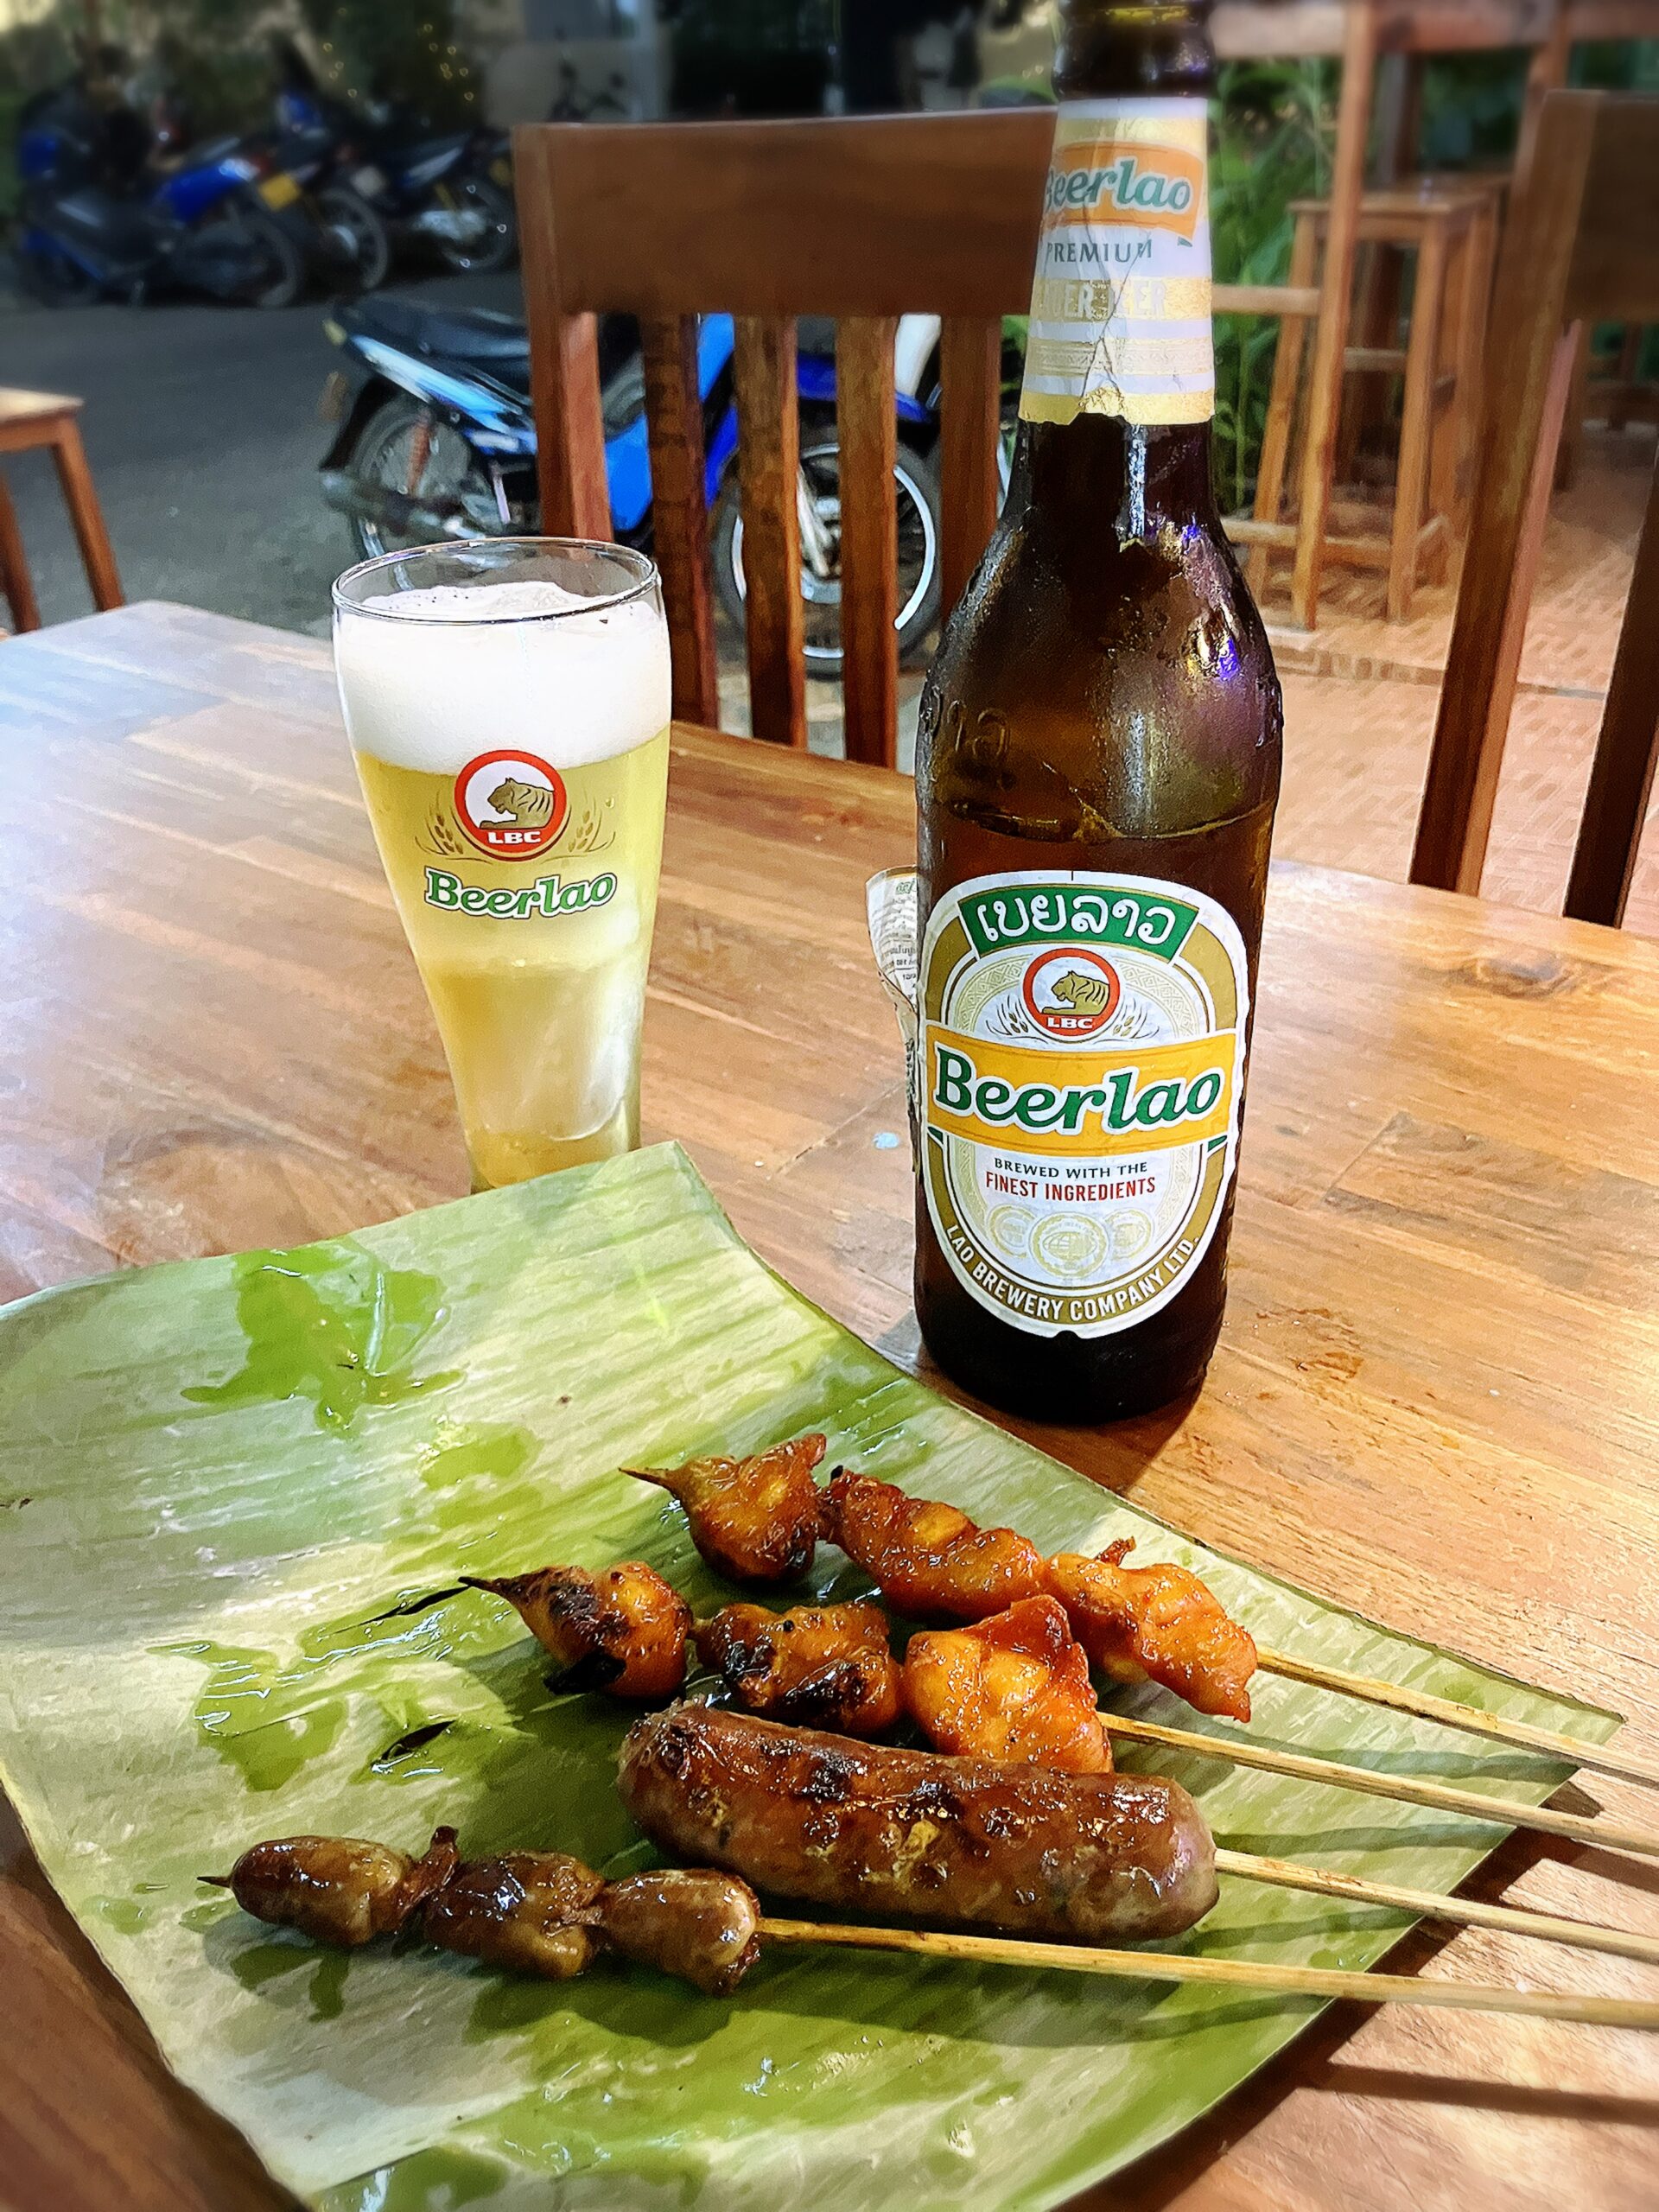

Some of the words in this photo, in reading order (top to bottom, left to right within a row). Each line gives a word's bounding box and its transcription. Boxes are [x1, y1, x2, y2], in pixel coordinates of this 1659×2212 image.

[1046, 159, 1191, 211] eerlao
[487, 830, 542, 845] LBC
[425, 867, 616, 918] Beerlao
[976, 893, 1177, 944] ເບຍລາວ
[1046, 1014, 1096, 1030] LBC
[934, 1041, 1224, 1131] Beerlao
[985, 1171, 1039, 1198] FINEST
[1046, 1176, 1156, 1202] INGREDIENTS
[994, 1157, 1059, 1179] BREWED
[1066, 1166, 1111, 1179] WITH
[1116, 1161, 1147, 1177] THE
[946, 1224, 975, 1263] LAO
[972, 1262, 1064, 1320] BREWERY
[1070, 1269, 1165, 1322] COMPANY
